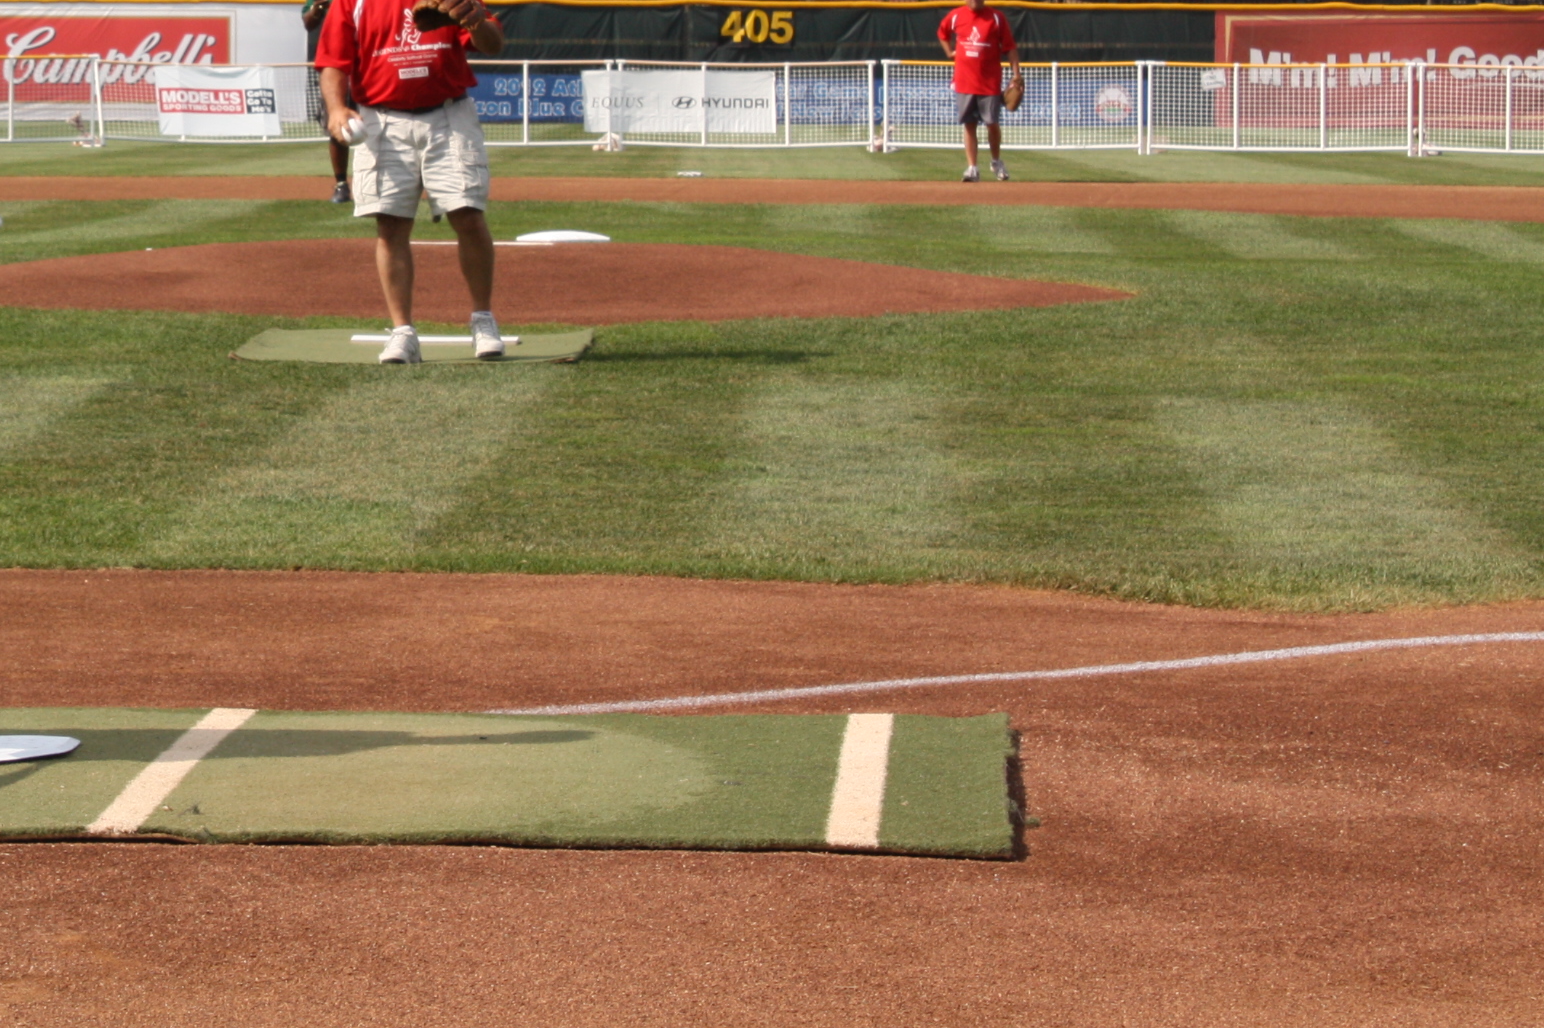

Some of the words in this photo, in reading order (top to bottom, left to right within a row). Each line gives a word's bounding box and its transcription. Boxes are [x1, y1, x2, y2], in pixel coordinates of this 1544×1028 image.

[721, 9, 794, 45] 405
[2, 25, 217, 91] Campbell's
[1448, 46, 1544, 81] Good
[494, 78, 547, 96] 202
[162, 90, 241, 105] MODELL'S
[474, 97, 512, 116] zon
[591, 96, 644, 110] EQUUS
[701, 98, 769, 109] HYUNDAI
[162, 104, 208, 112] SPORTING
[209, 104, 242, 112] GOODS
